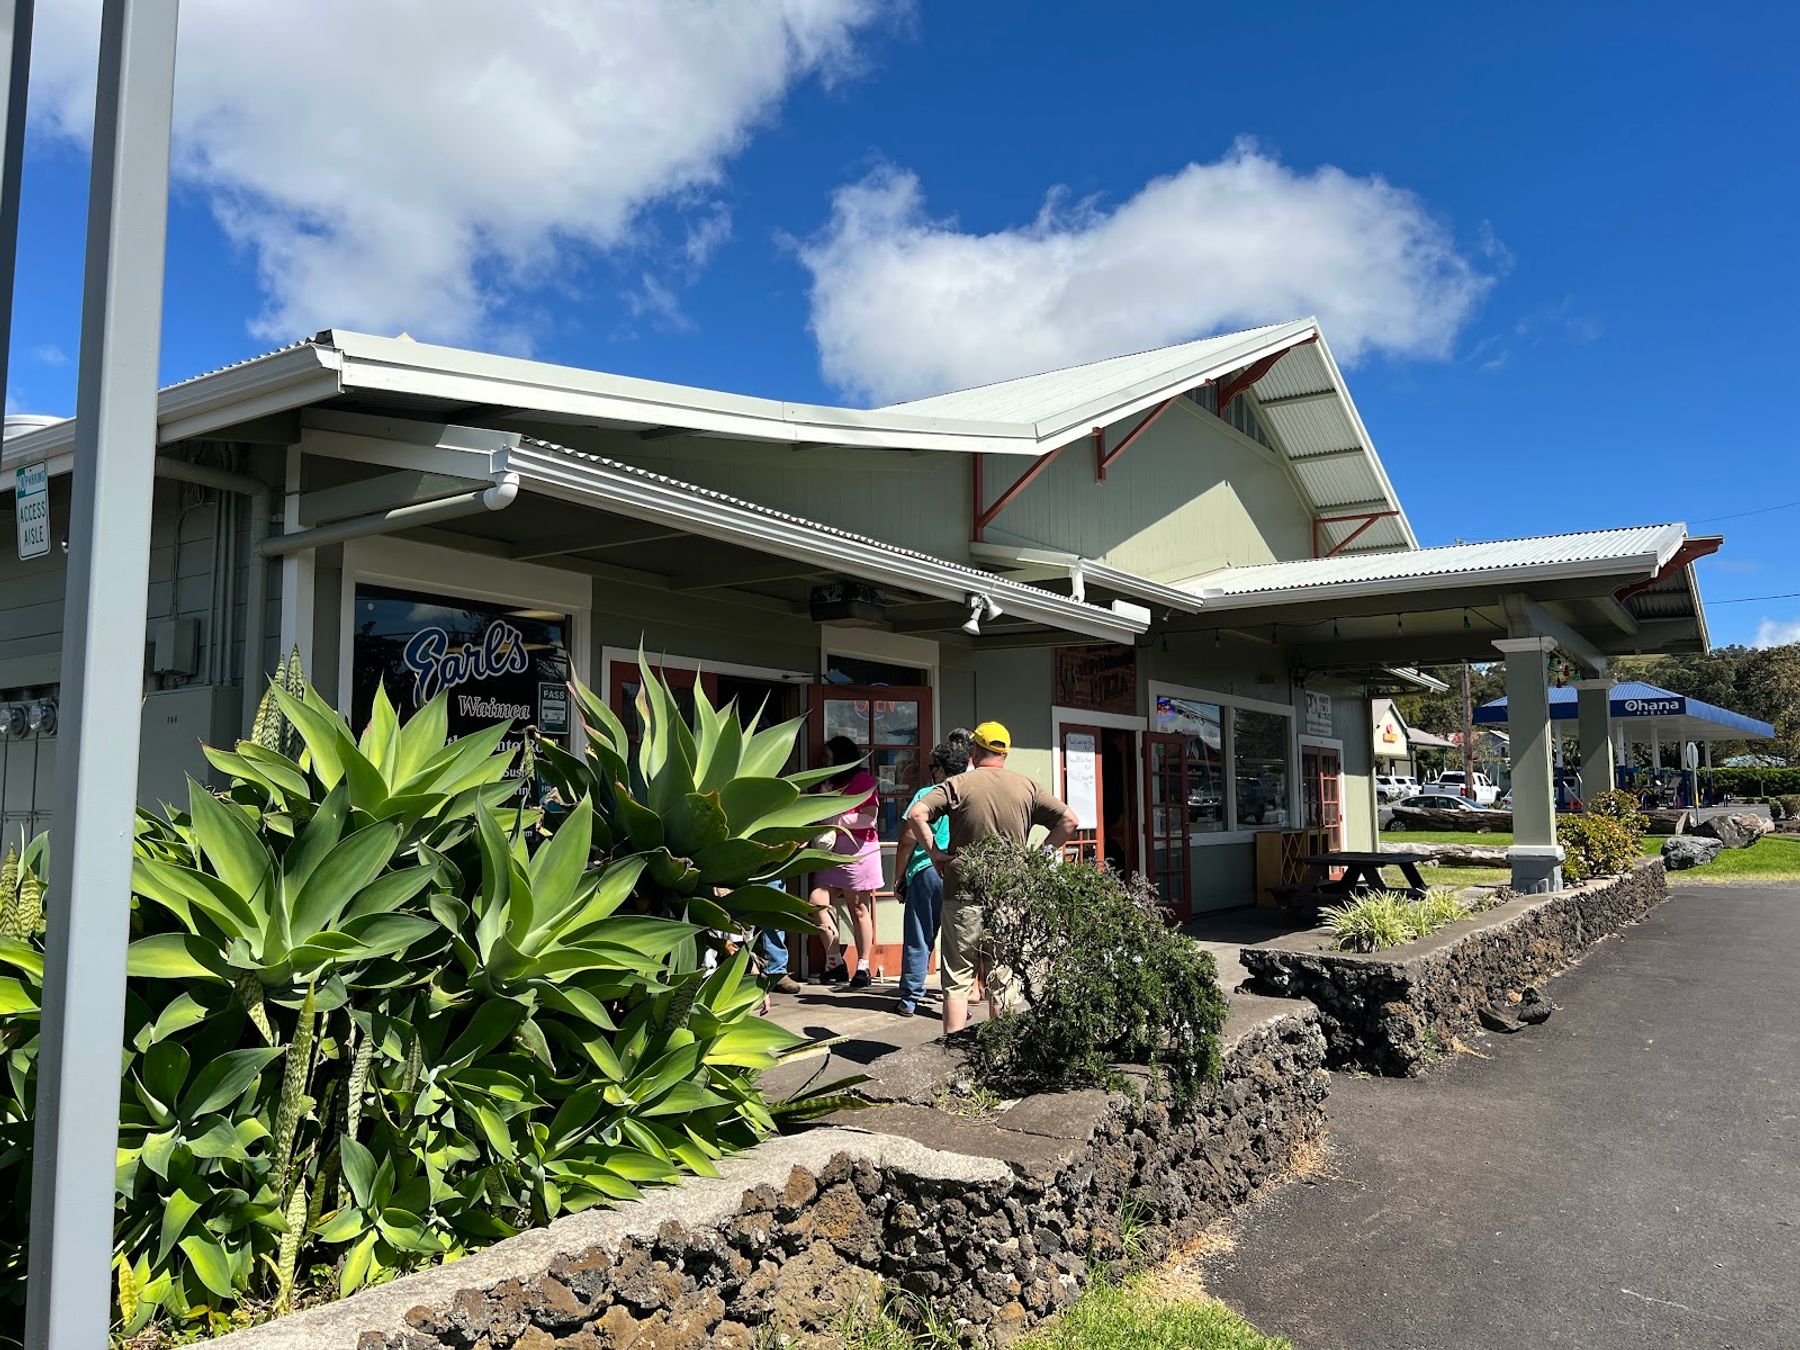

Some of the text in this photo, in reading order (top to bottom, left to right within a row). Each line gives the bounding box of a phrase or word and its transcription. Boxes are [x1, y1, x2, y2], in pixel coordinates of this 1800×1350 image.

[20, 501, 46, 523] ACCESS
[24, 526, 44, 546] AISLE
[404, 620, 528, 708] Earl's
[543, 689, 565, 700] PASS
[458, 695, 530, 719] Waimea
[1625, 700, 1679, 712] Ohana
